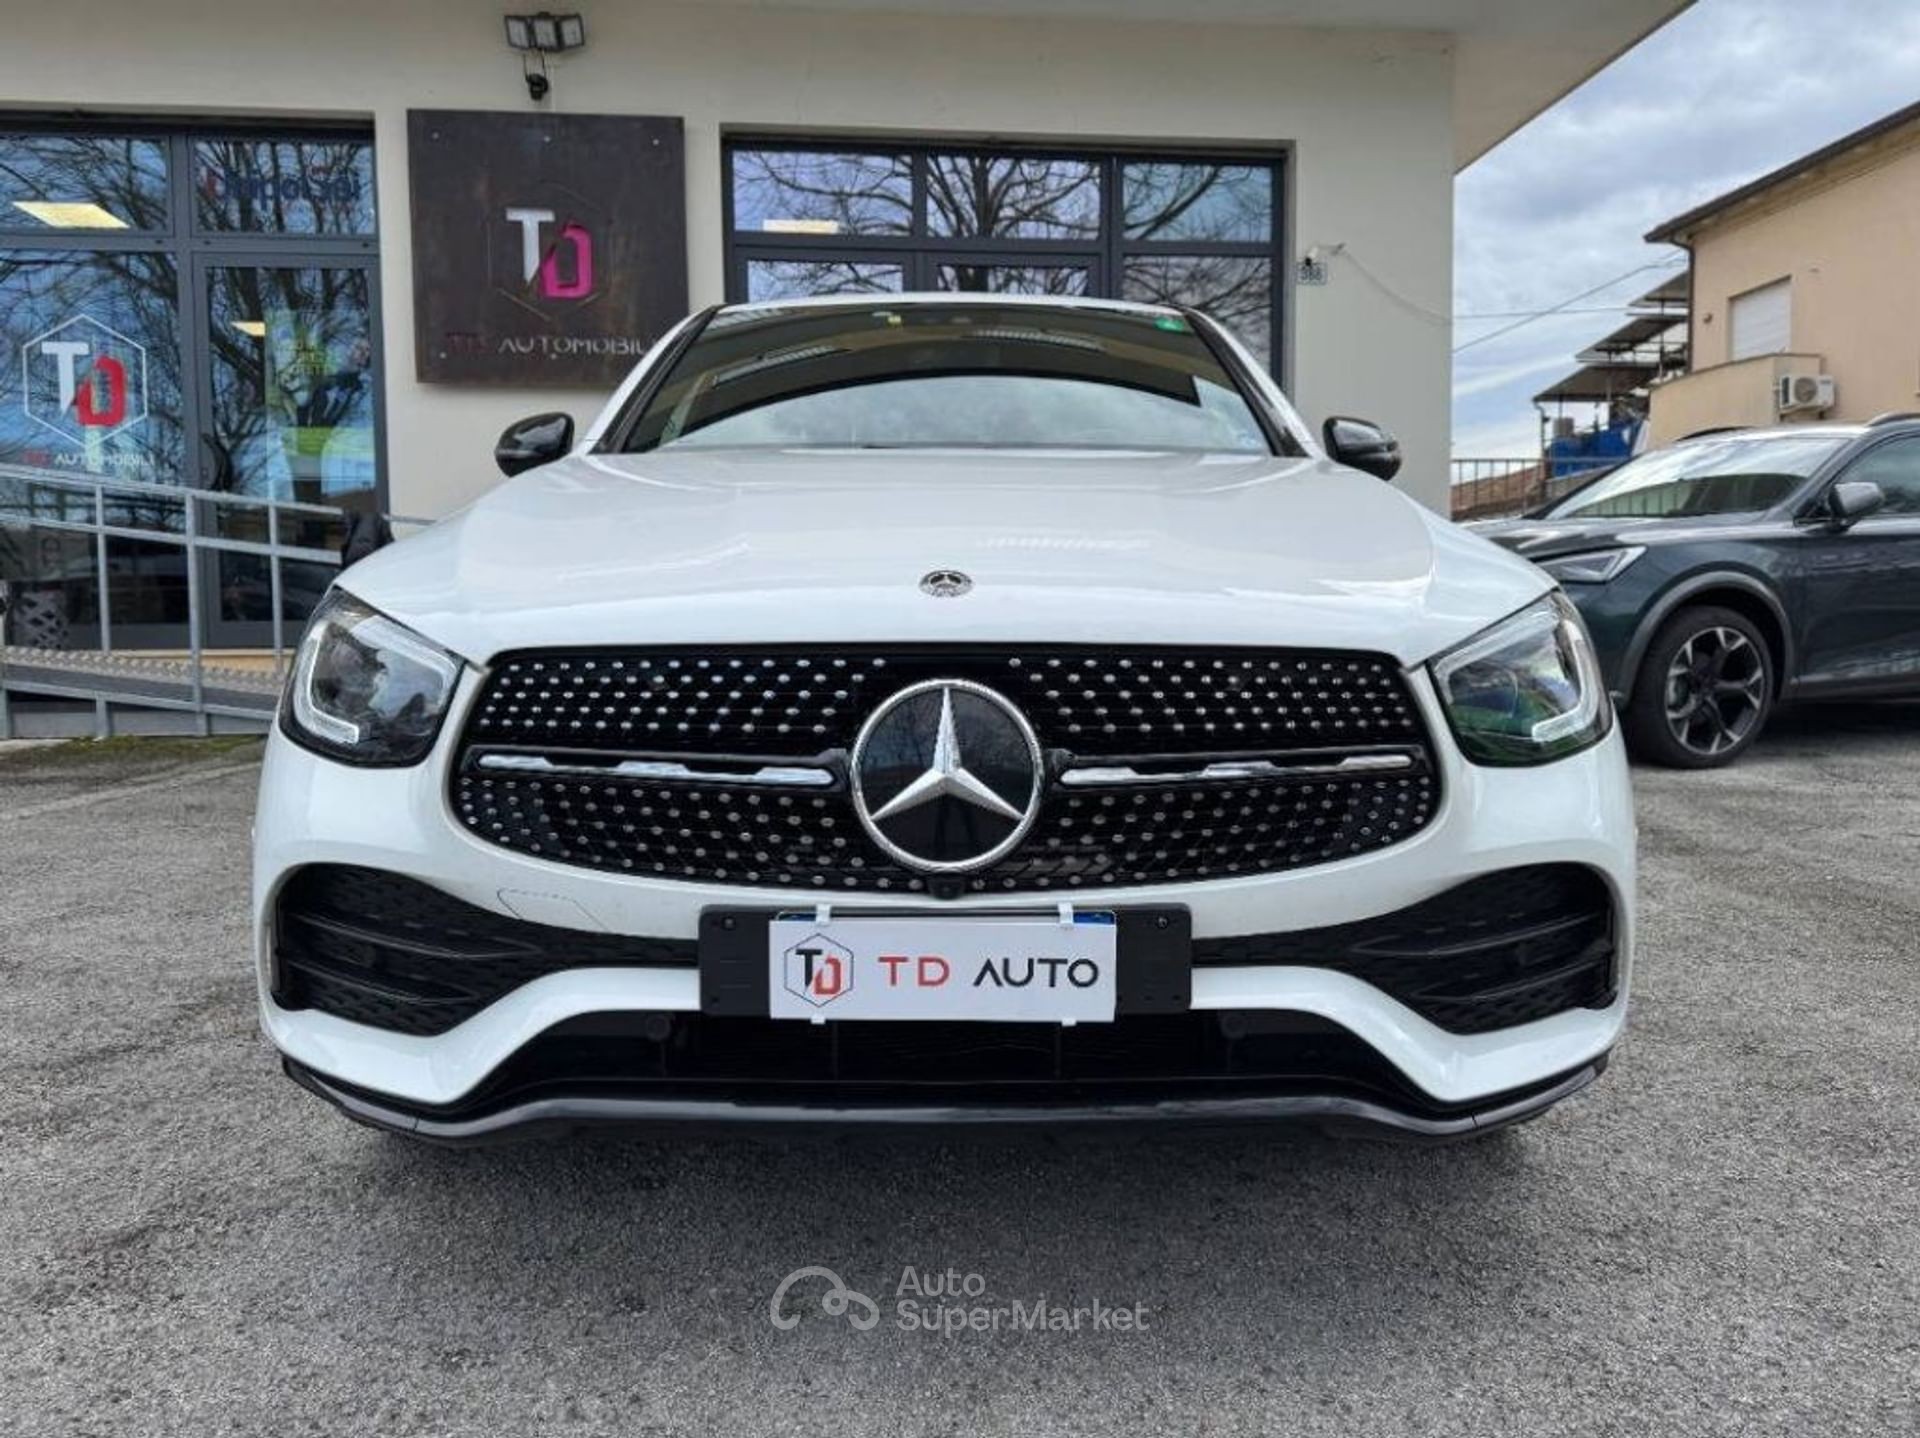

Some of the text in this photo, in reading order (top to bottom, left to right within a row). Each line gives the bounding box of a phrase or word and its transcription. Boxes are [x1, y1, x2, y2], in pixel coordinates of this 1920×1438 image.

[498, 335, 657, 356] AUTOMOBIL
[877, 956, 1100, 988] TD AUTO
